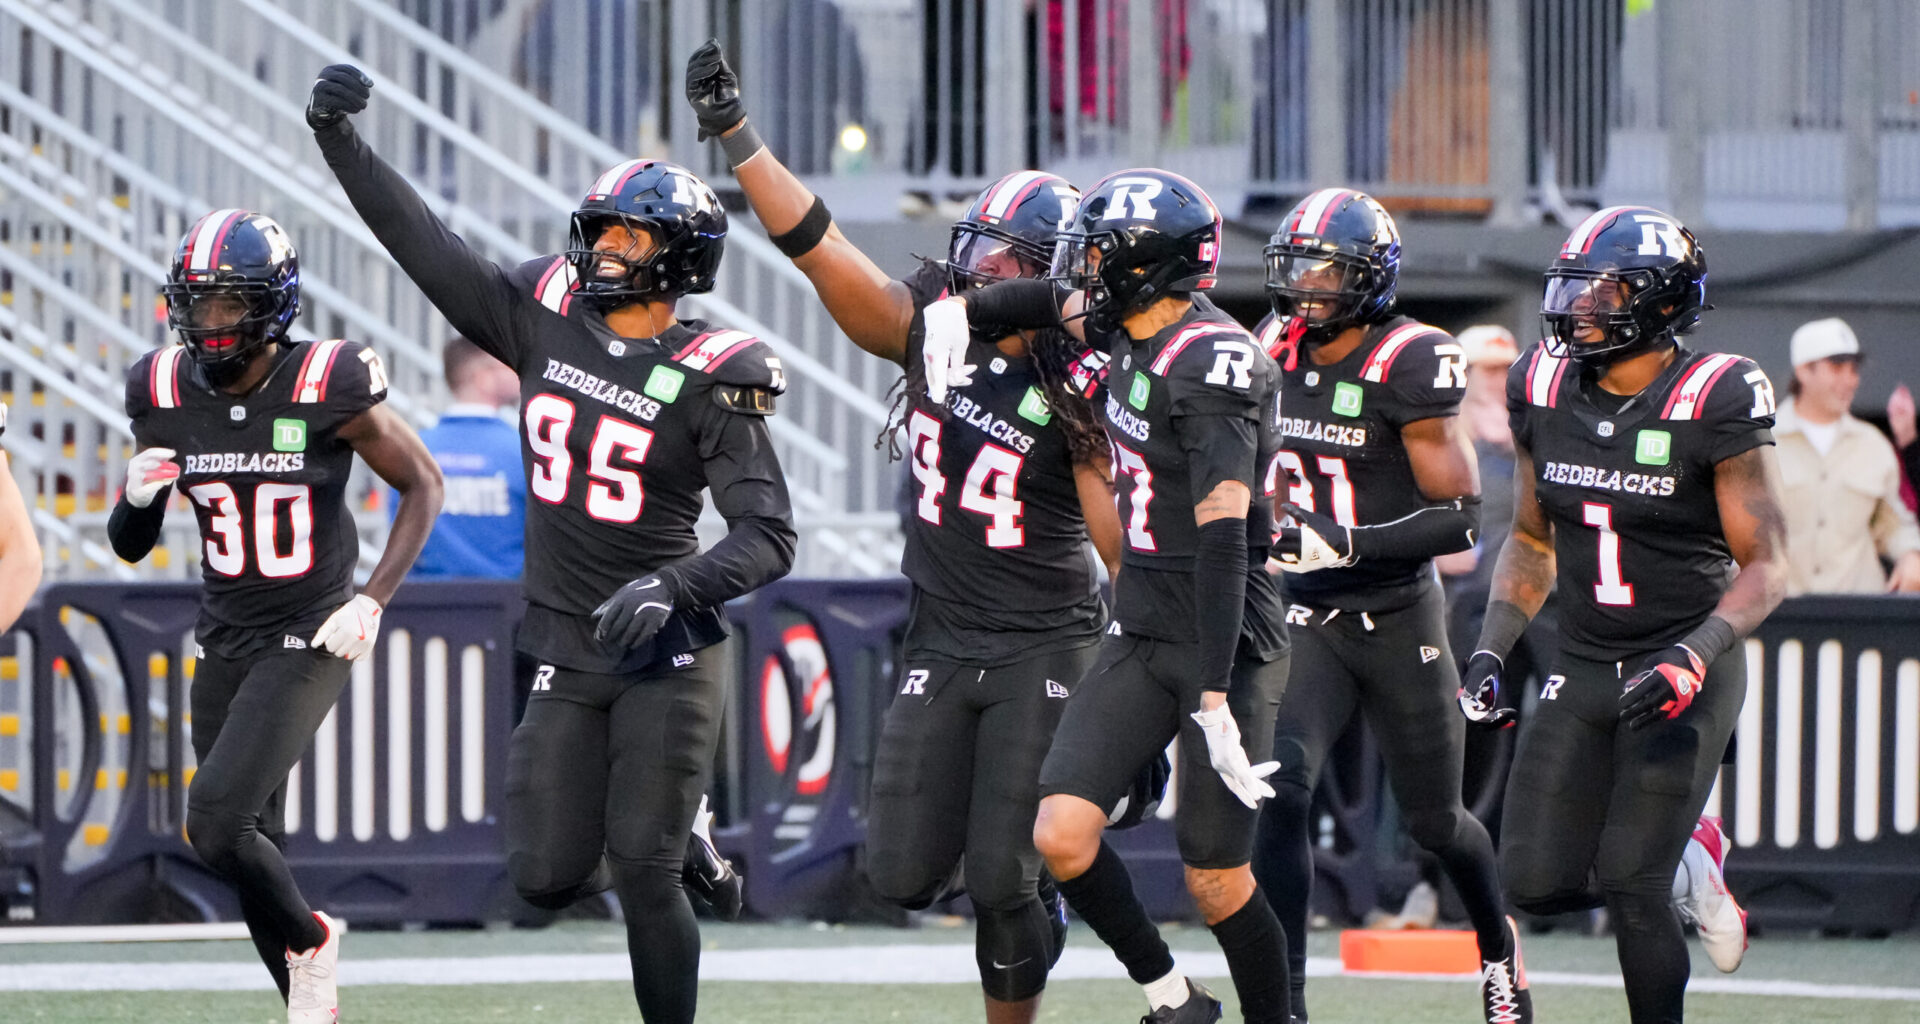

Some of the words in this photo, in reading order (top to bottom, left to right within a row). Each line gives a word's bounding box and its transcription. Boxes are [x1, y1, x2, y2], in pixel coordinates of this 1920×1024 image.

[1102, 177, 1164, 221] R
[1633, 213, 1688, 261] R
[654, 372, 679, 395] TD
[1205, 341, 1254, 389] R
[1433, 343, 1468, 389] R
[542, 358, 662, 421] REDBLACKS
[1339, 388, 1360, 410] TD
[1743, 368, 1776, 419] R
[277, 425, 304, 445] TD
[1280, 416, 1367, 448] DBLACKS
[1641, 437, 1666, 458] TD
[184, 452, 305, 475] REDBLACKS
[524, 392, 655, 524] 95
[908, 407, 1025, 549] 44
[1543, 461, 1675, 497] REDBLACKS
[1105, 430, 1158, 553] 7
[1264, 449, 1358, 529] 31
[187, 481, 315, 578] 30
[1582, 501, 1635, 607] 1
[1285, 603, 1314, 627] R
[532, 665, 555, 691] R
[901, 669, 930, 695] R
[1539, 674, 1566, 700] R
